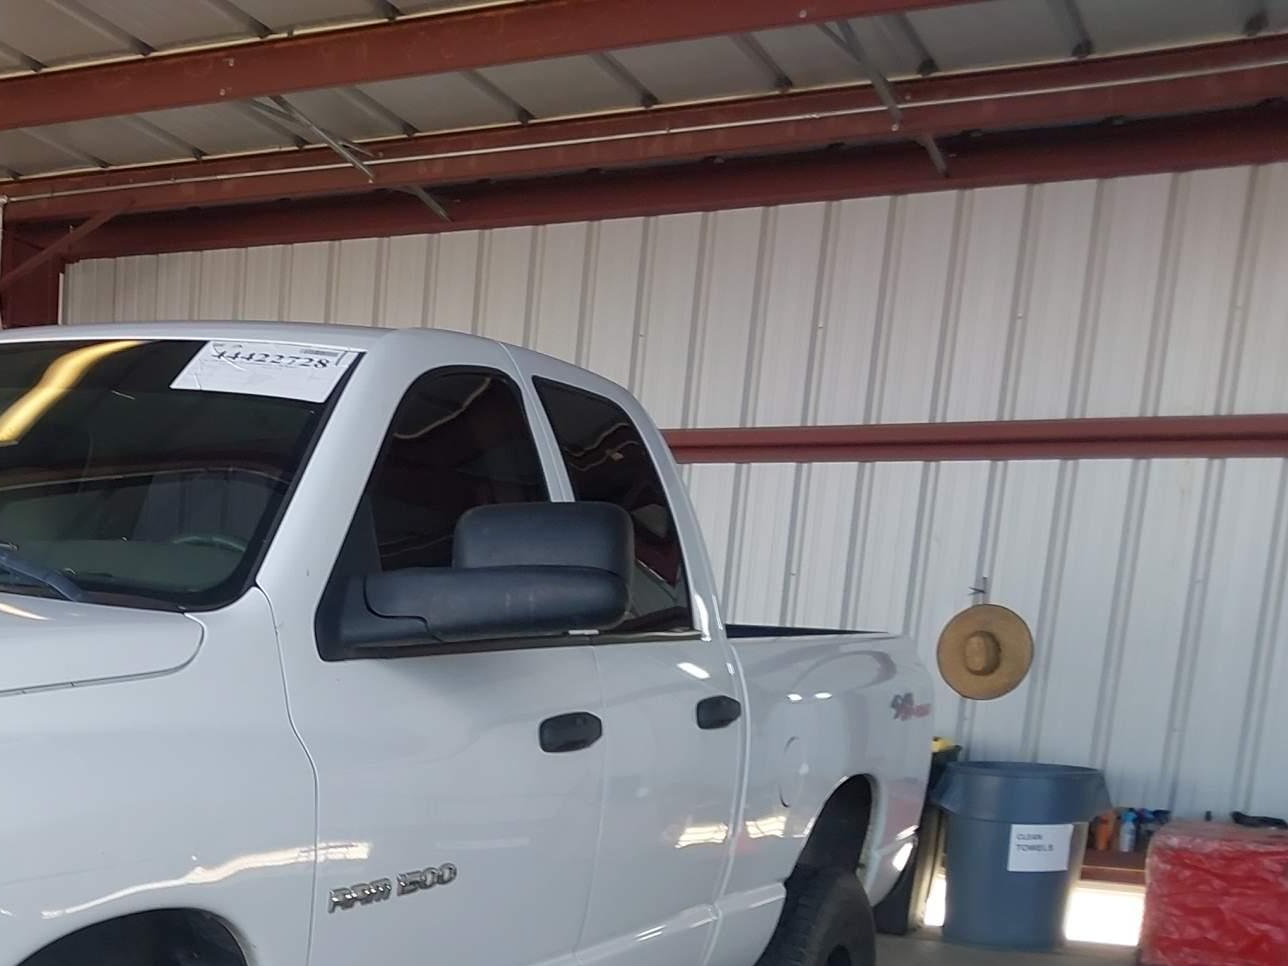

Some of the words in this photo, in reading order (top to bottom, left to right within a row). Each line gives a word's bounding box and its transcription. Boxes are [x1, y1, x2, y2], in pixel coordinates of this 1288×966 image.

[212, 351, 330, 368] 44422728
[328, 878, 392, 913] RAM
[396, 863, 457, 896] 1500
